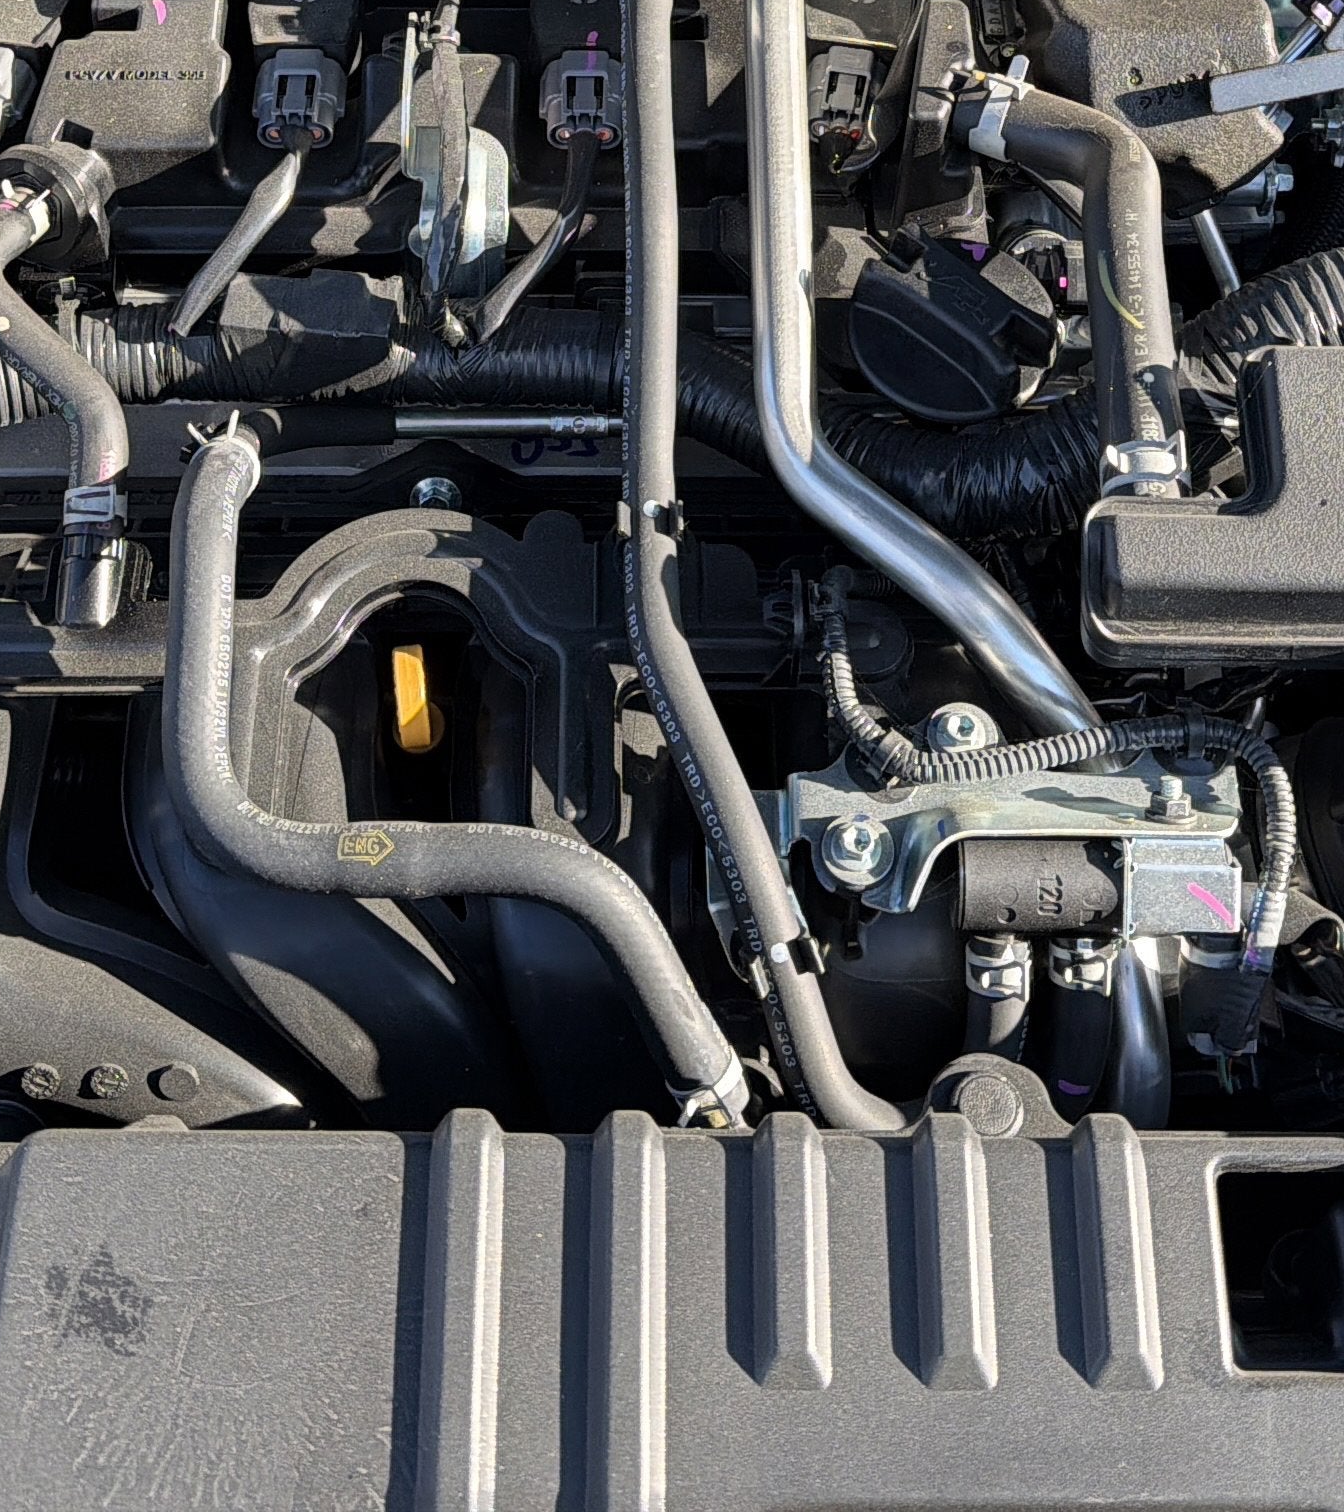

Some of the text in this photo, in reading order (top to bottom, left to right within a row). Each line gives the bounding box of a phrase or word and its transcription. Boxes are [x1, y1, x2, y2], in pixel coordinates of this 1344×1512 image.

[623, 328, 631, 360] TRD
[220, 574, 231, 602] DOT
[626, 603, 642, 639] TRD
[218, 635, 231, 687] 050225
[632, 641, 661, 699] >ECO<
[655, 700, 681, 744] 5303
[679, 752, 702, 789] TRD
[696, 790, 727, 852] >ECO<
[342, 833, 380, 858] ENG
[720, 854, 748, 904] 5303
[742, 917, 764, 954] TRD
[774, 1020, 796, 1069] 5303
